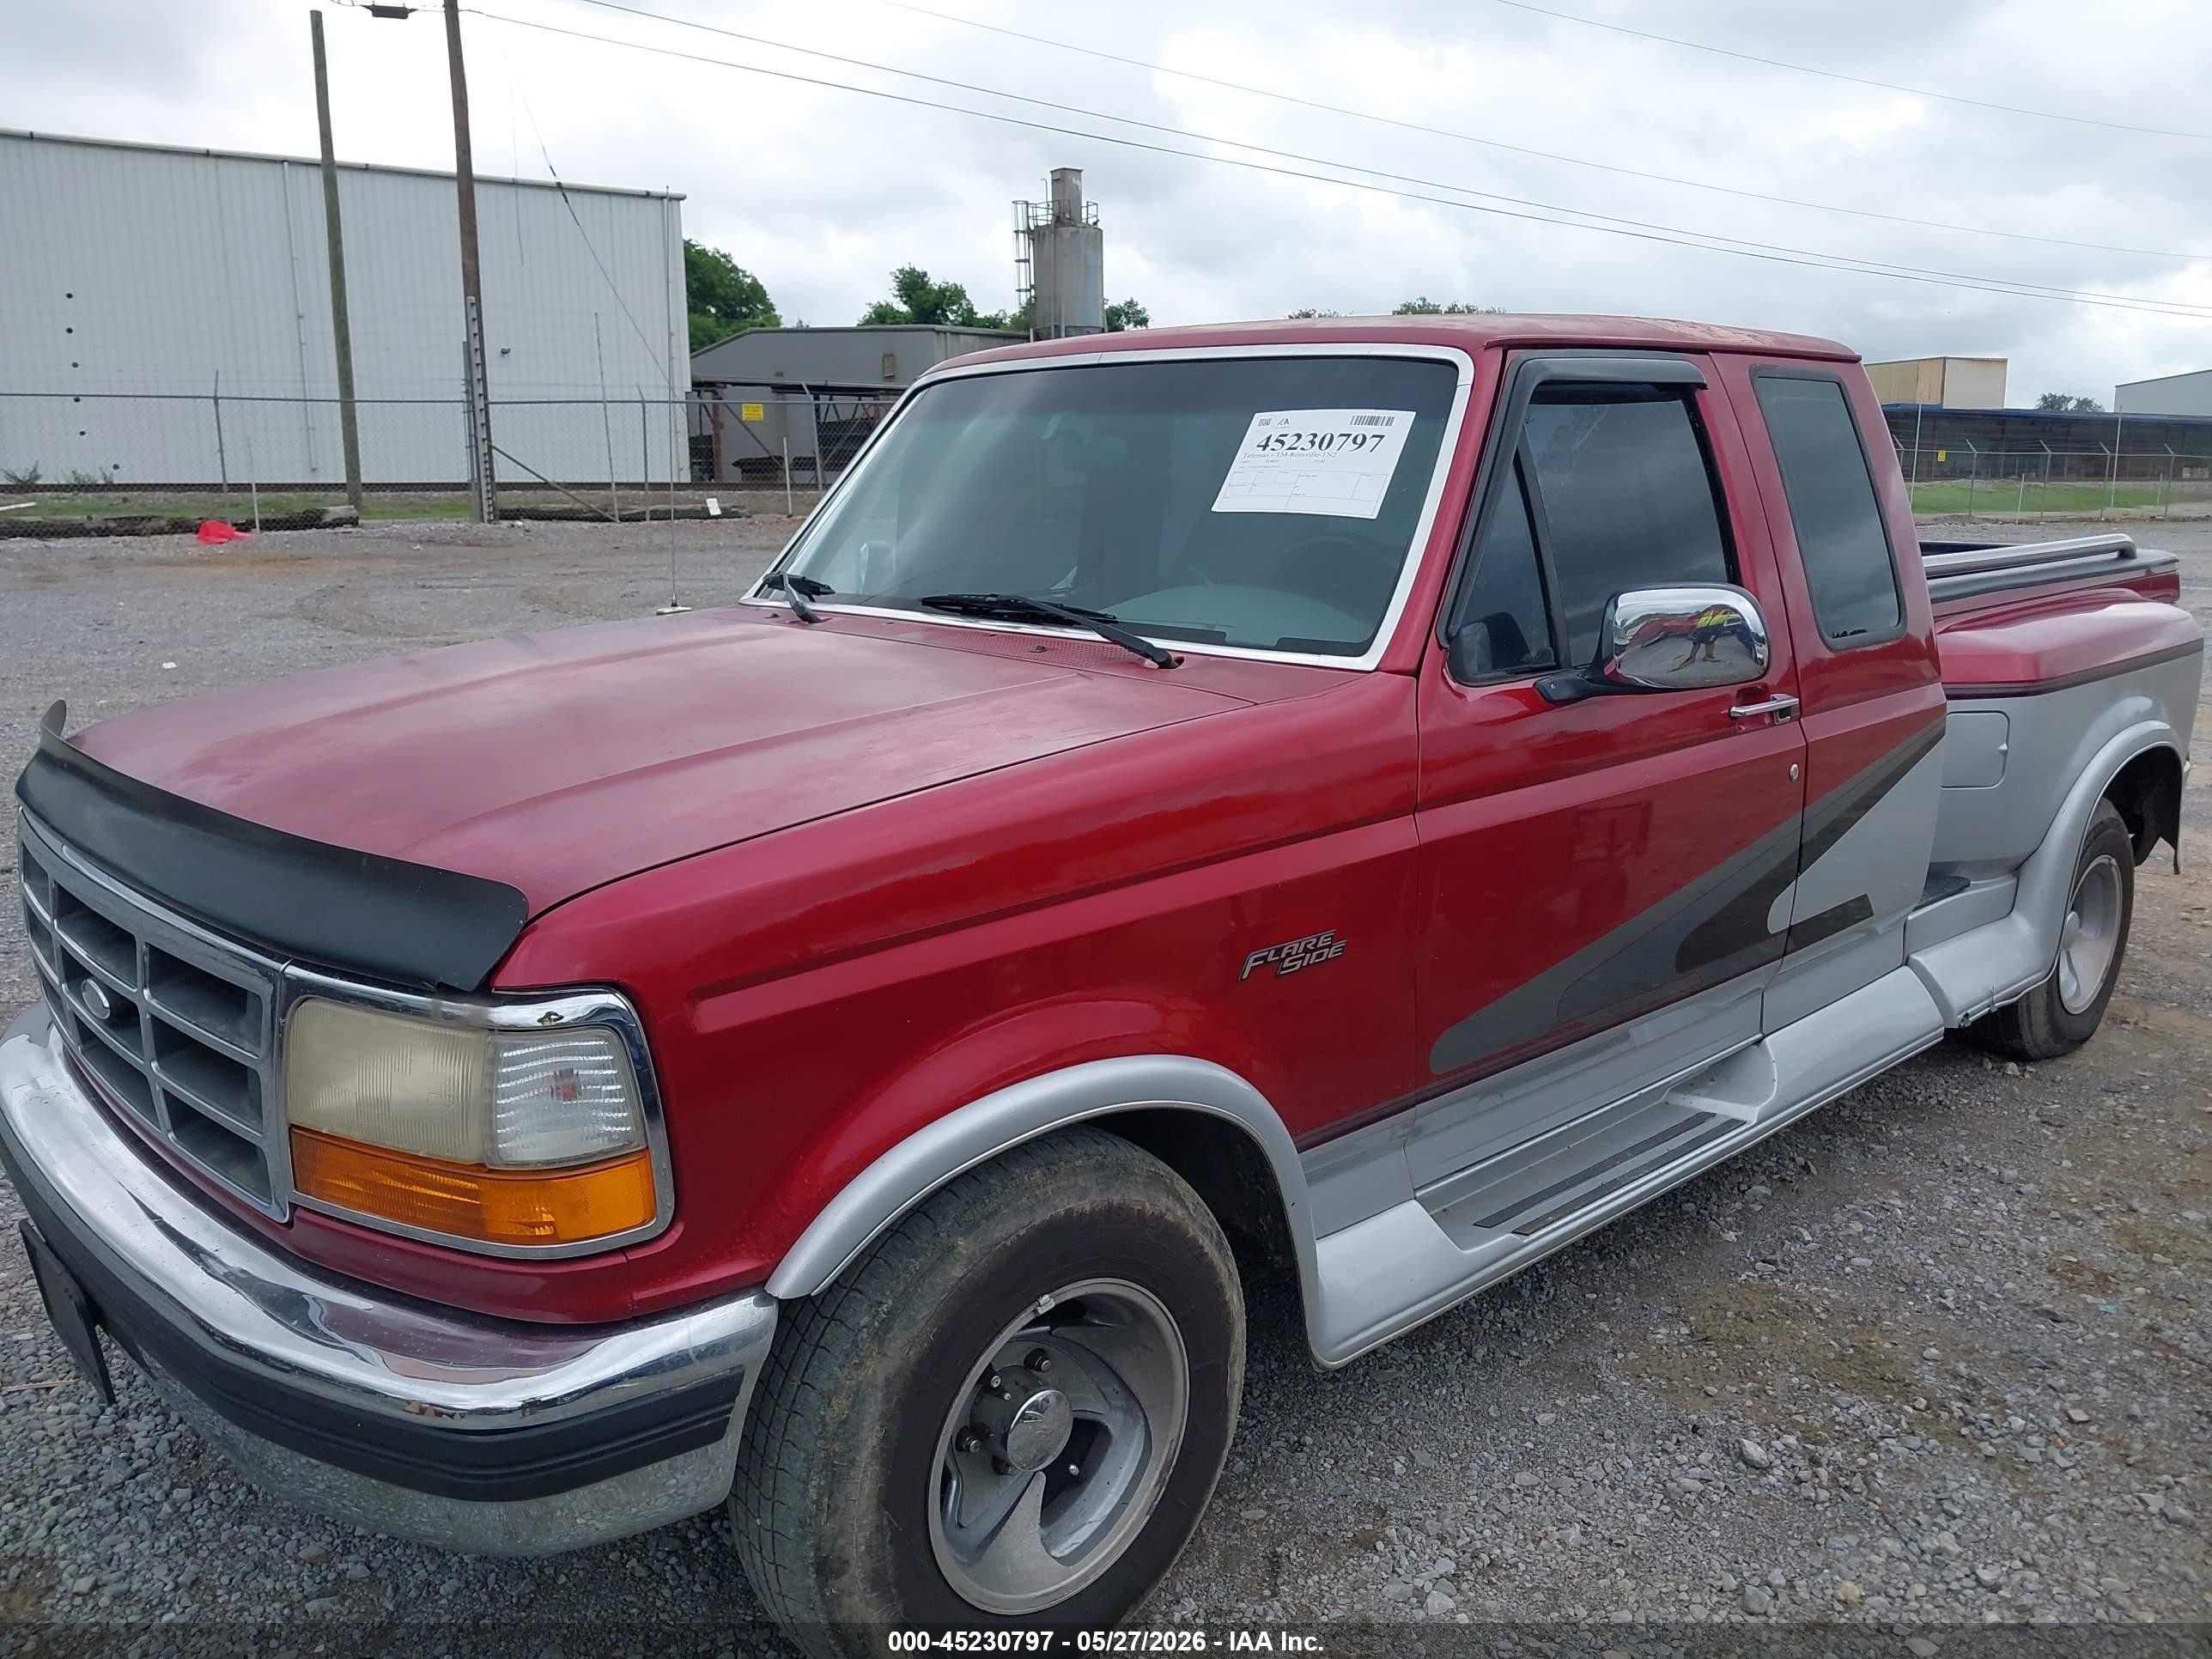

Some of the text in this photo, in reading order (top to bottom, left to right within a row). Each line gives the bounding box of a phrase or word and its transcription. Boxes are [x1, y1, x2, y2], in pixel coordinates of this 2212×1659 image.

[1255, 432, 1386, 453] 45230797
[1239, 929, 1337, 981] FLARE
[1278, 939, 1347, 975] SIDE
